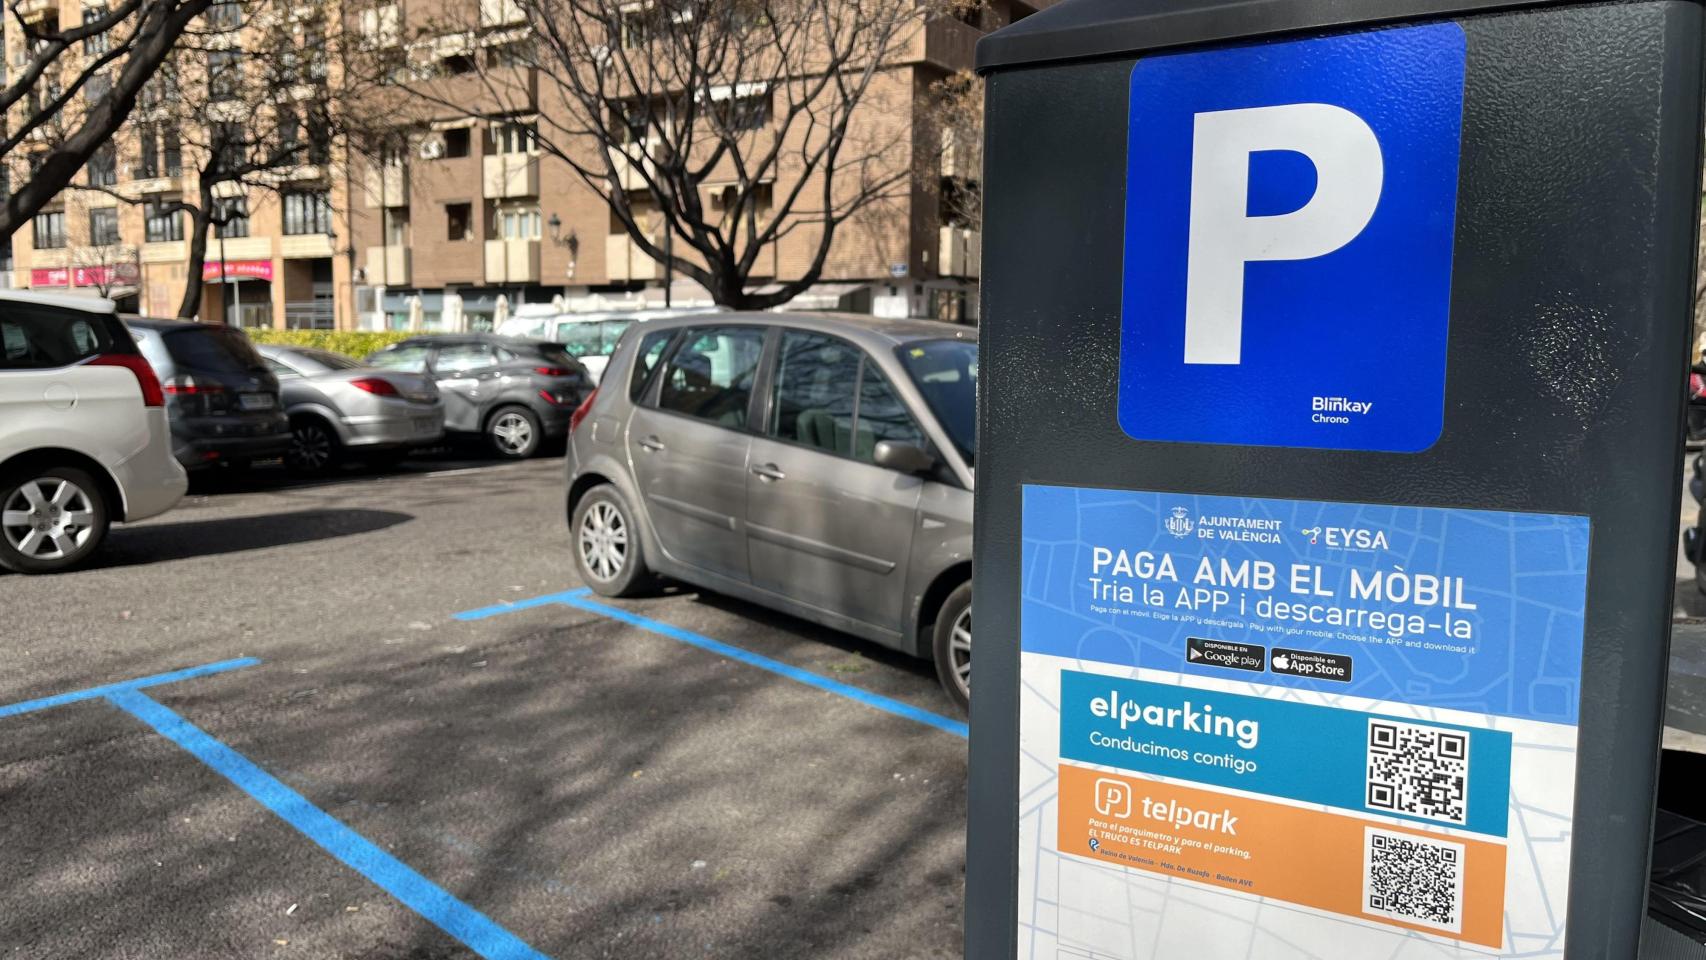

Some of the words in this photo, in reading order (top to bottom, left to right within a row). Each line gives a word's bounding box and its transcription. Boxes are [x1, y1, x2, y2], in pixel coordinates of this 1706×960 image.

[1184, 103, 1384, 364] P
[1312, 396, 1372, 415] Blinkay
[1312, 413, 1349, 424] Chrono
[1199, 516, 1282, 531] AJUNTAMENT
[1198, 528, 1214, 538] DE
[1219, 530, 1282, 544] VALÈNCIA
[1325, 527, 1389, 550] EYSA
[1093, 547, 1178, 582] PAGA
[1193, 556, 1276, 591] AMB
[1290, 564, 1334, 597] EL
[1350, 564, 1477, 610] MÒBIL
[1089, 577, 1133, 604] Tria
[1143, 583, 1165, 607] la
[1175, 587, 1230, 613] APP
[1240, 592, 1246, 616] i
[1256, 595, 1472, 639] descarrega-la
[1090, 606, 1107, 614] Paga
[1152, 612, 1170, 620] Elige
[1250, 622, 1264, 632] Pay
[1267, 624, 1284, 632] with
[1286, 627, 1304, 636] your
[1337, 632, 1366, 642] Choose
[1369, 634, 1383, 644] the
[1386, 637, 1402, 646] APP
[1405, 640, 1422, 648] and
[1424, 641, 1467, 654] download
[1468, 646, 1476, 654] it
[1204, 642, 1238, 652] DISPONIBLE
[1290, 653, 1326, 663] Disponible
[1204, 651, 1240, 666] Google
[1240, 655, 1261, 668] play
[1290, 660, 1314, 674] App
[1315, 664, 1345, 676] Store
[1090, 690, 1259, 750] elparking
[1089, 730, 1189, 761] Conducimos
[1194, 750, 1257, 774] contigo
[1142, 796, 1238, 836] telpark
[1088, 828, 1098, 837] EL
[1100, 831, 1128, 843] TRUCO
[1130, 837, 1140, 846] ES
[1144, 840, 1182, 854] TELPARK
[1110, 822, 1118, 831] el
[1173, 836, 1180, 845] y
[1204, 841, 1212, 850] el
